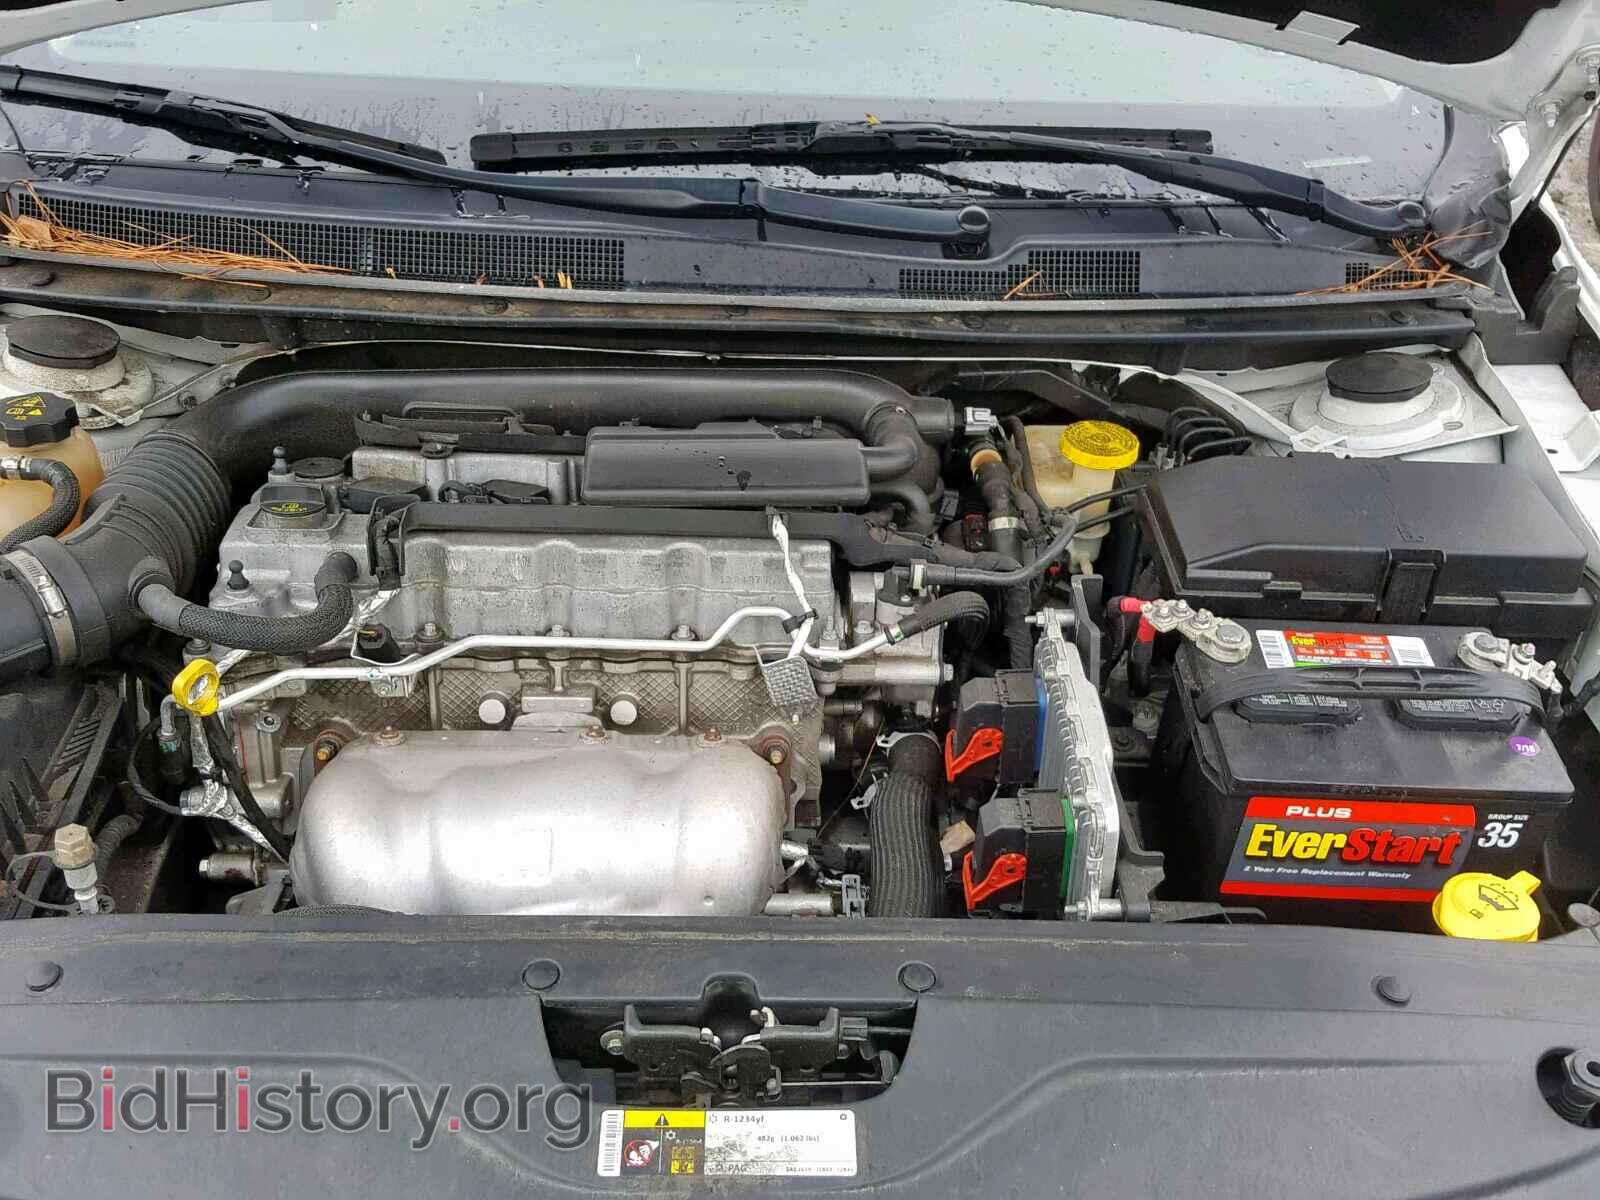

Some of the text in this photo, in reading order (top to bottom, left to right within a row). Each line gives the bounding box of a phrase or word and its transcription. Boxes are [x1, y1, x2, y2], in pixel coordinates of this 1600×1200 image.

[1285, 805, 1353, 819] PLUS
[1245, 823, 1462, 865] EverStart
[1478, 821, 1524, 848] 35
[1300, 868, 1366, 878] Replacement
[1367, 871, 1411, 880] Warranty
